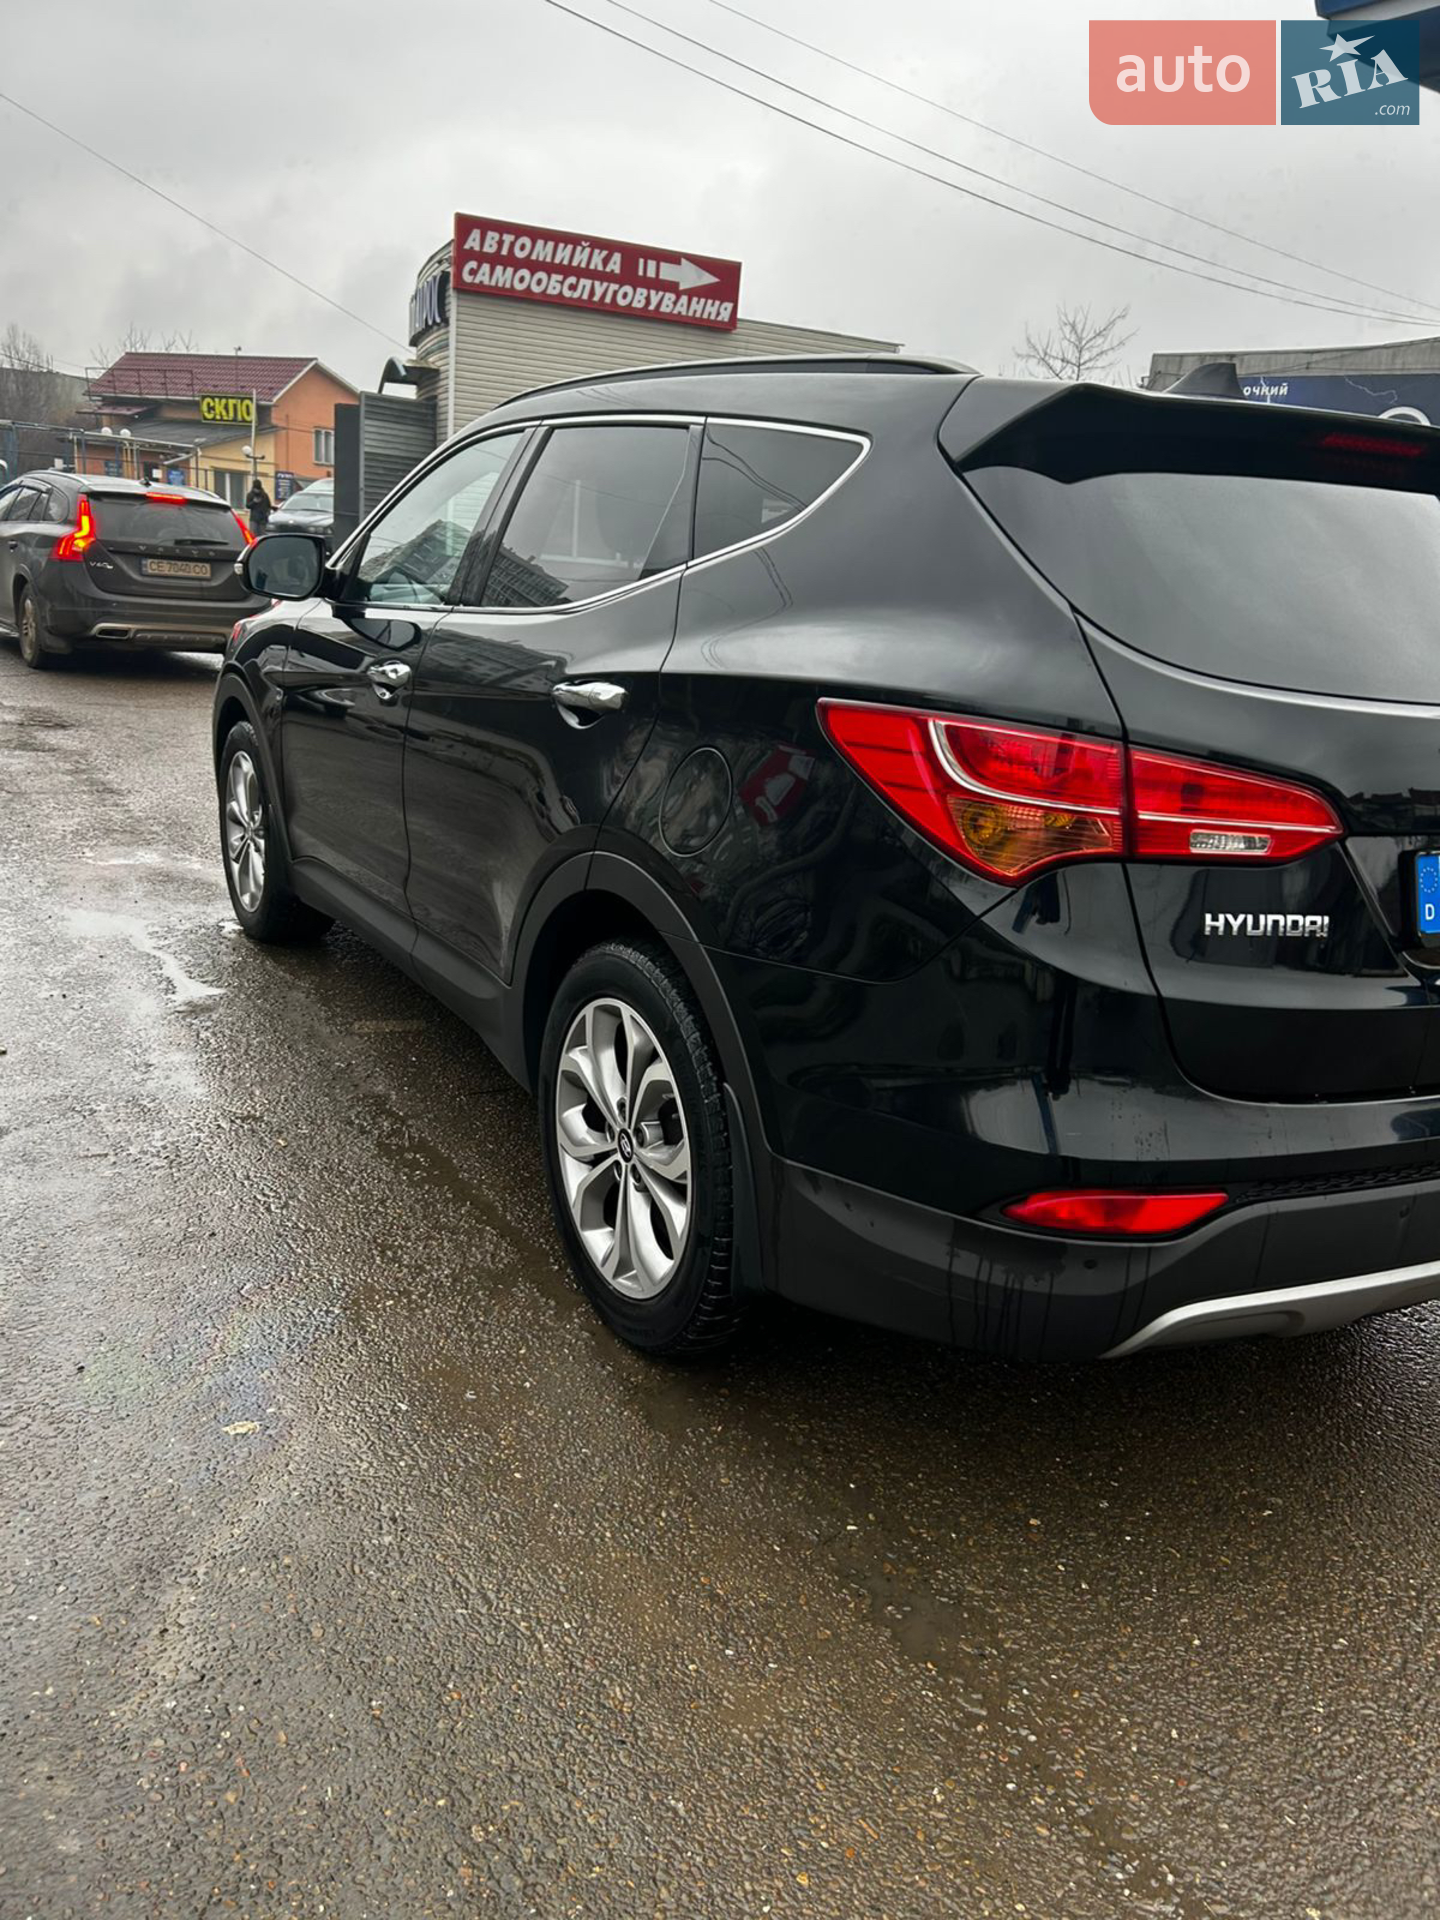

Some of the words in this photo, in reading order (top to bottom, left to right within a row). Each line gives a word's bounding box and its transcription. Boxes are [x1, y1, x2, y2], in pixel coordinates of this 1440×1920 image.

[463, 228, 622, 275] АВТОМИЙКА
[461, 260, 734, 322] САМООБСЛУГОВУВАННЯ
[1243, 382, 1289, 396] очний
[202, 397, 255, 422] СКЛО
[1425, 903, 1436, 921] D
[1204, 912, 1330, 938] HYUNDAI
